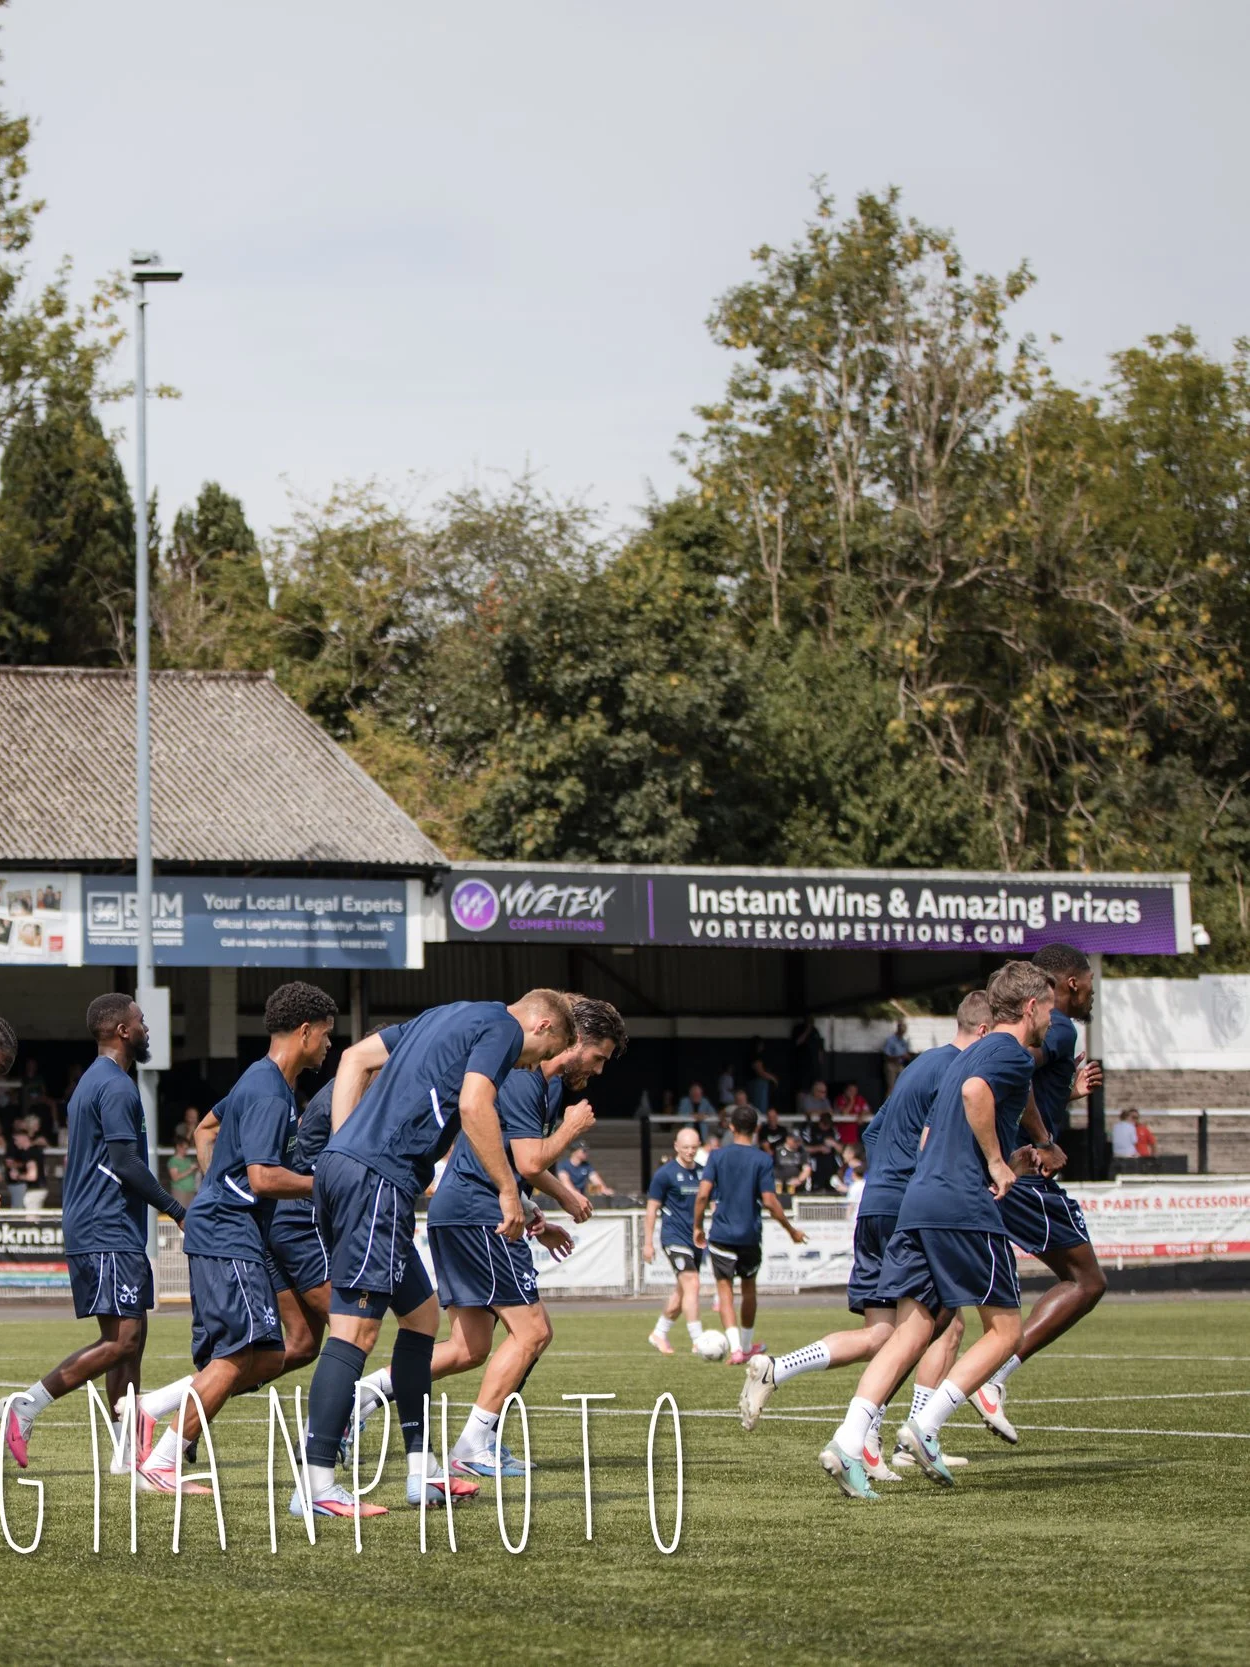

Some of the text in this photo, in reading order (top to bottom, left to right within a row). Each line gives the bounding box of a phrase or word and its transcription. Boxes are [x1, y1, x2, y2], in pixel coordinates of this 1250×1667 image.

[203, 893, 403, 915] Your Local Legal Experts
[500, 878, 617, 918] VORTEX
[688, 883, 1142, 930] Instant Wins & Amazing Prizes
[380, 920, 396, 932] FC
[509, 918, 606, 932] COMPETITIONS
[689, 919, 1024, 945] VORTEXCOMPETITIONS.COM
[1104, 1199, 1149, 1210] PARTS
[1154, 1198, 1163, 1209] &
